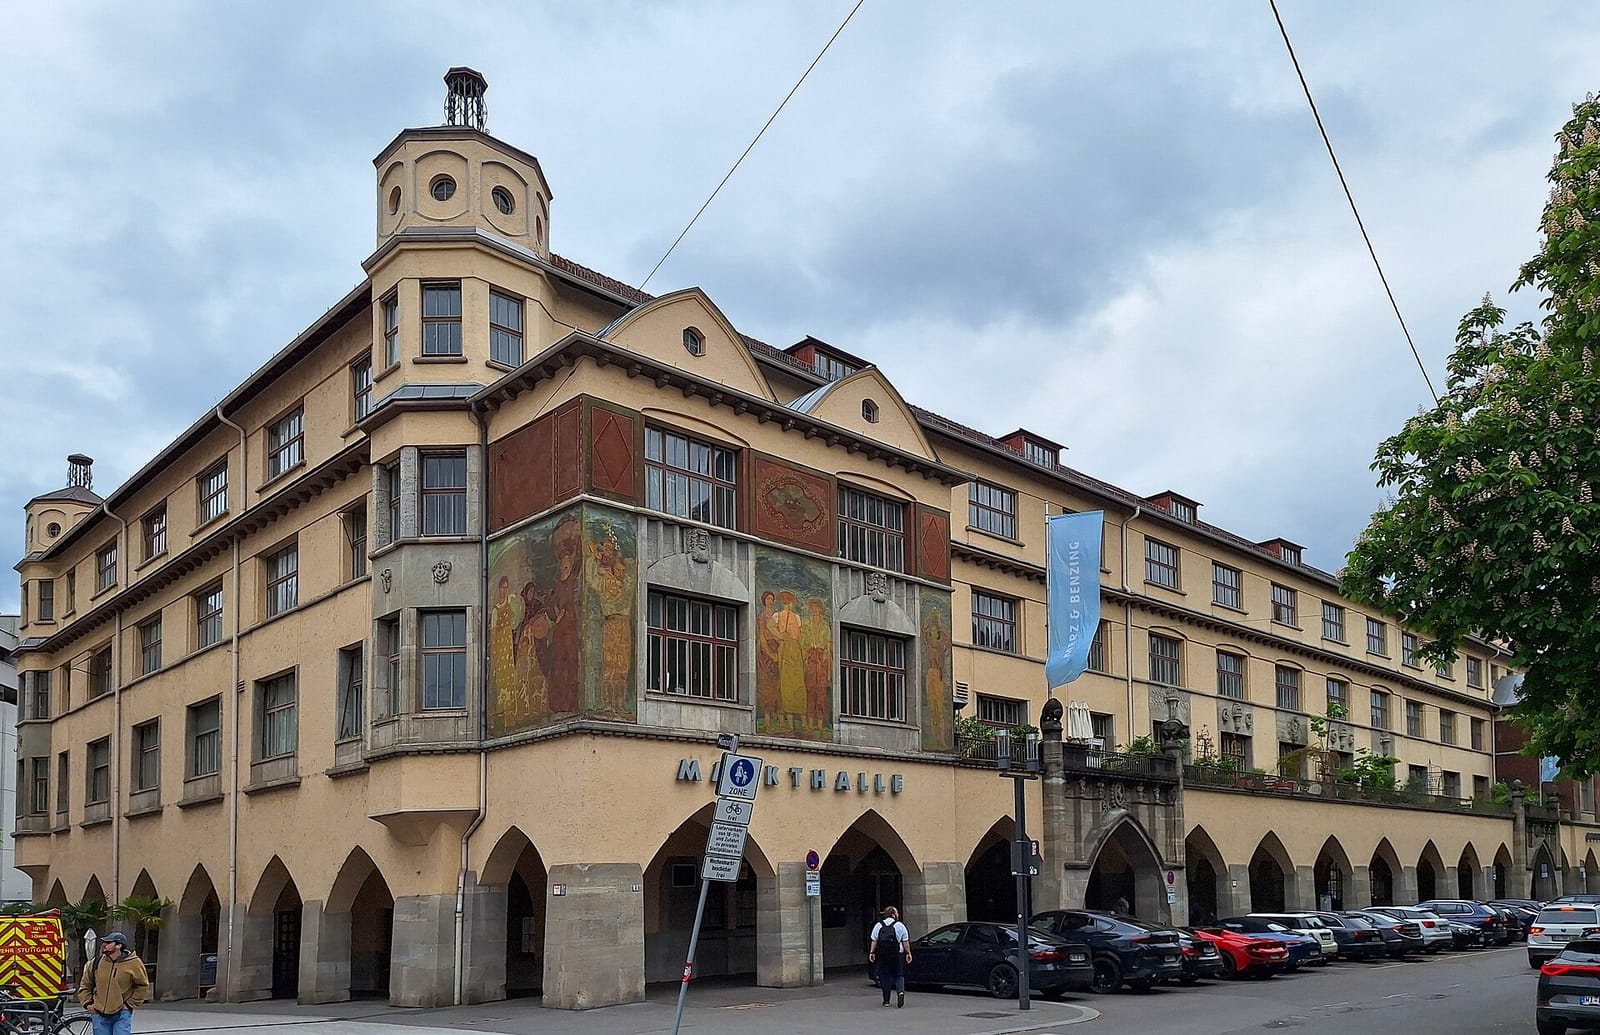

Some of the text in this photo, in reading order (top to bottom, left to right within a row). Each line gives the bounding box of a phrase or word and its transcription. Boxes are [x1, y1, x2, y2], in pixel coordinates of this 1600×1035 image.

[1069, 541, 1081, 603] BENZING
[1070, 608, 1080, 619] &
[677, 759, 903, 794] MKTHALLE
[729, 786, 748, 796] ZONE
[17, 946, 54, 954] STUTTGART
